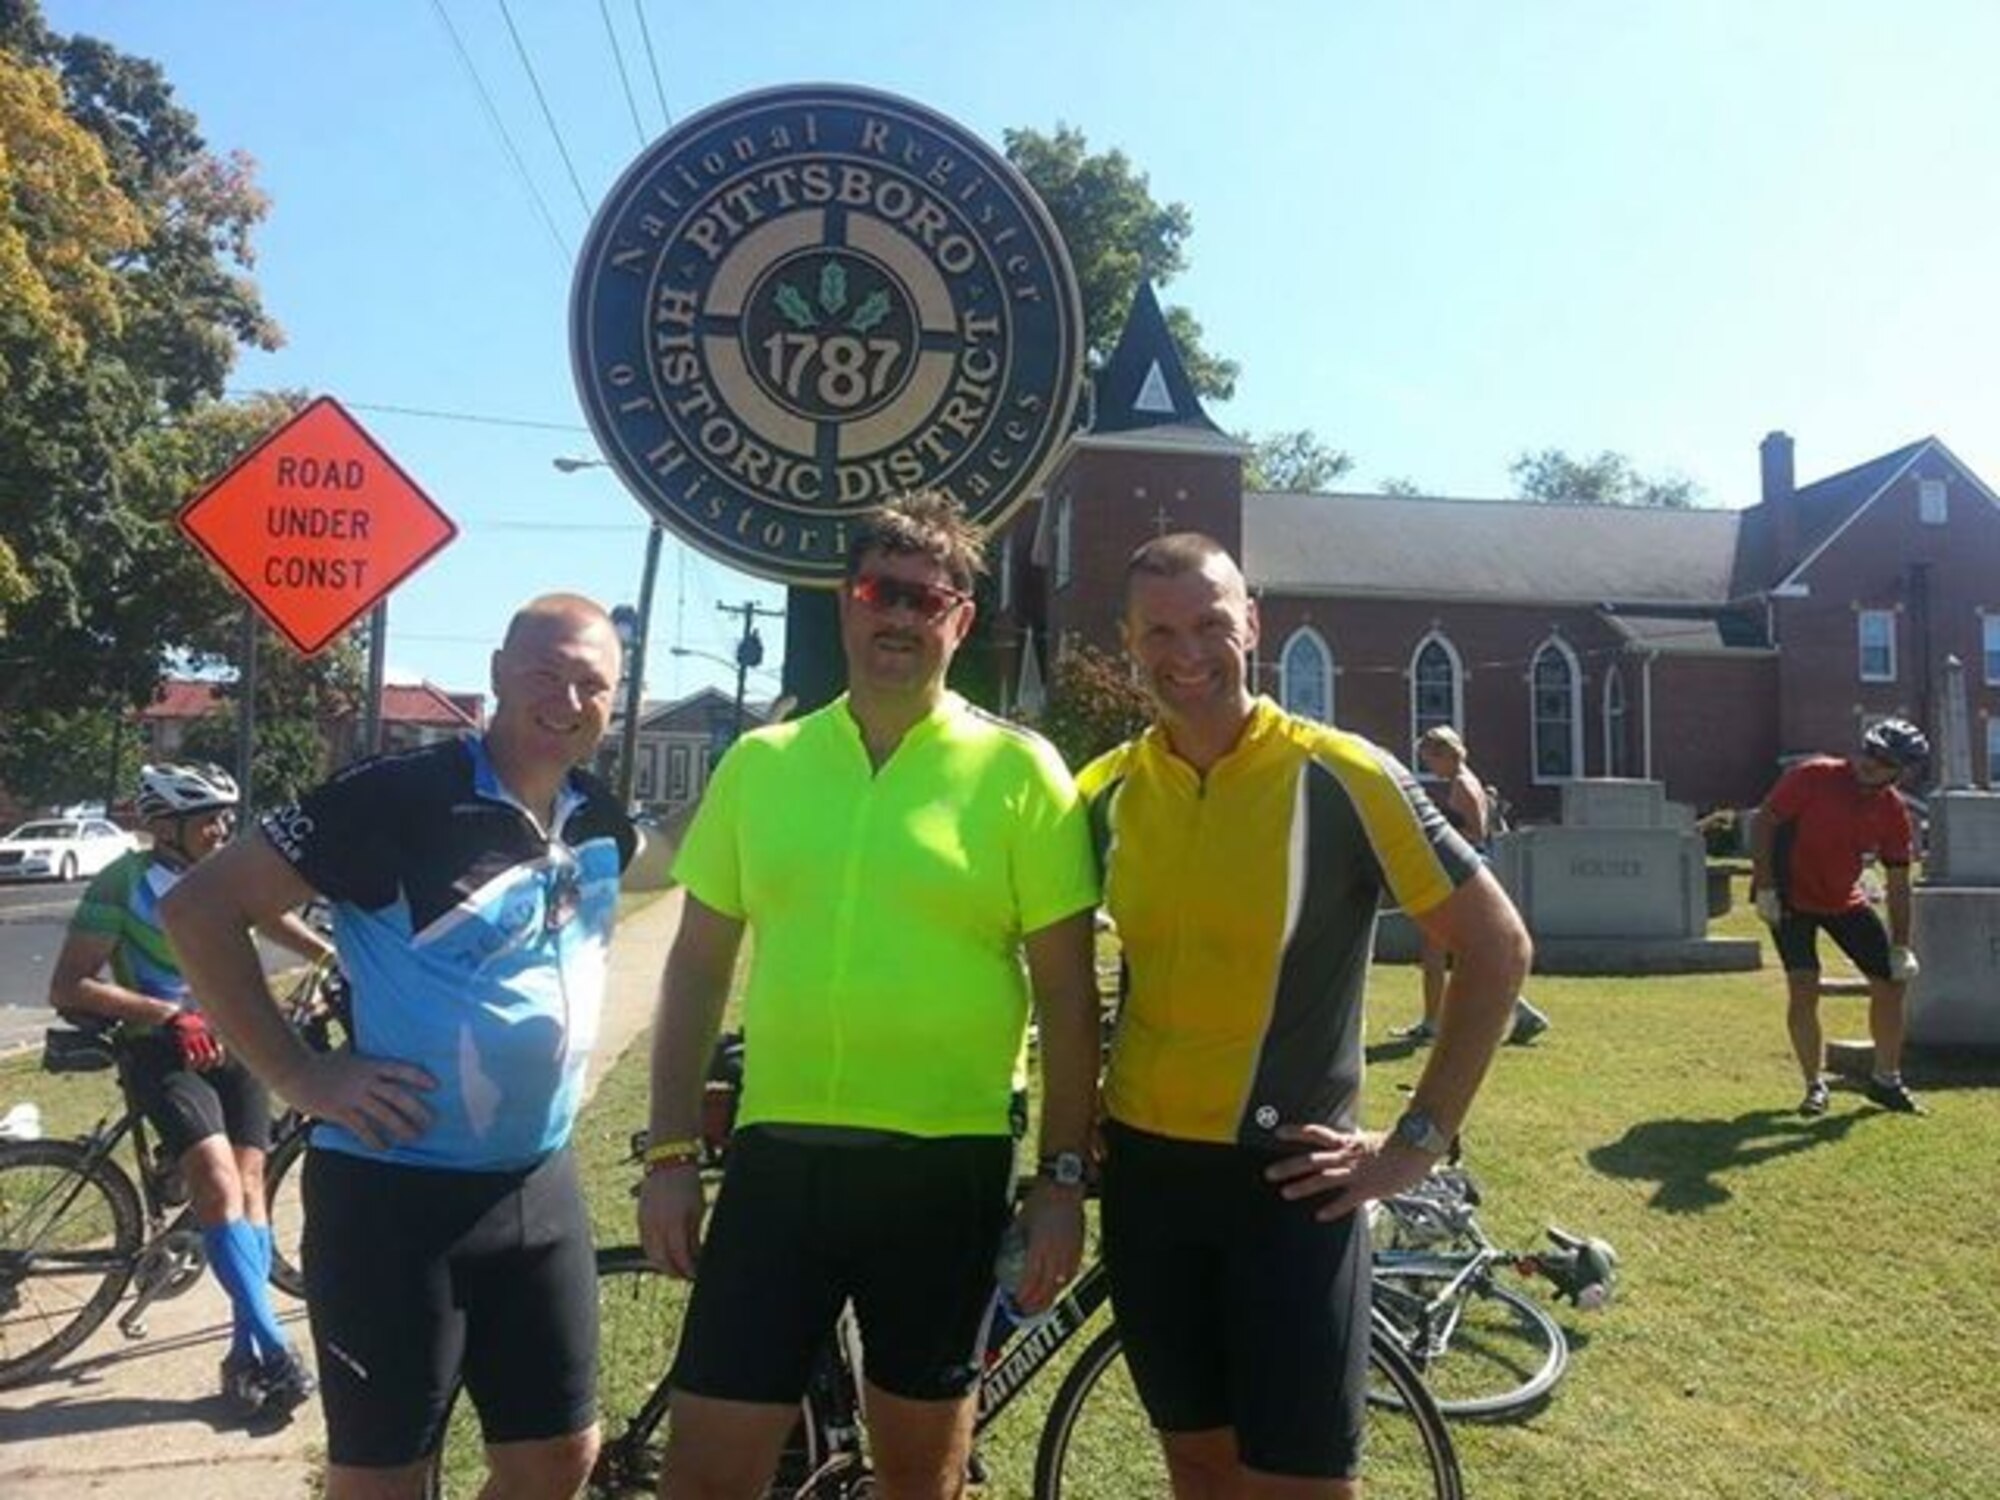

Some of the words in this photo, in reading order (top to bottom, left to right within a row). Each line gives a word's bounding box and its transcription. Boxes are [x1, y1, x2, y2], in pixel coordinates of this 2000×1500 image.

[611, 112, 818, 275] National
[861, 116, 1041, 303] Register
[684, 163, 977, 274] PITTSBORO
[655, 284, 824, 501] HISTORIC
[834, 309, 1000, 504] DISTRICT
[762, 332, 901, 409] 1787
[277, 456, 365, 491] ROAD
[607, 363, 655, 413] of
[646, 438, 849, 555] Histori
[940, 394, 1041, 513] laces
[266, 507, 370, 540] UNDER
[264, 556, 369, 590] CONST
